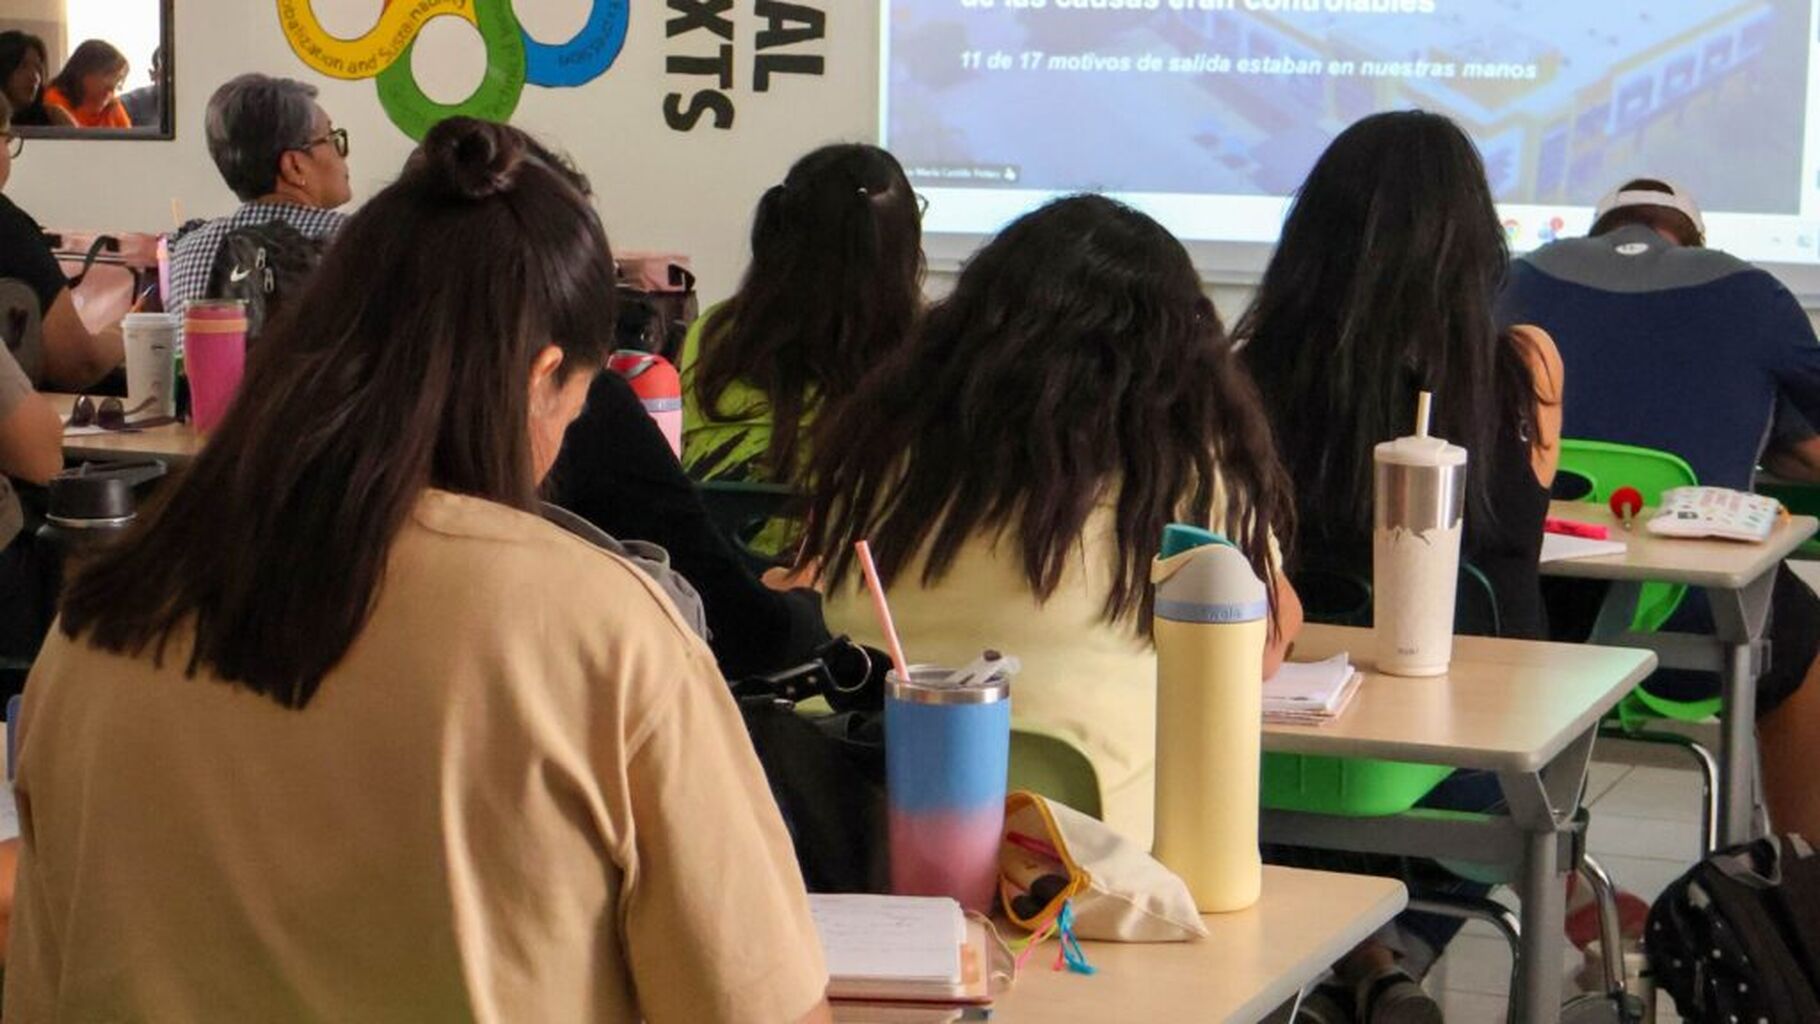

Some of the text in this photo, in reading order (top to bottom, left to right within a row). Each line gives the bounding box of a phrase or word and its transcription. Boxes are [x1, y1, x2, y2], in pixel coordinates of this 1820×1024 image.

[347, 54, 377, 74] and
[663, 0, 735, 132] XTS
[753, 0, 826, 92] AL
[962, 51, 1537, 79] 11 de 17 motivos de salida estaban en nuestras manos
